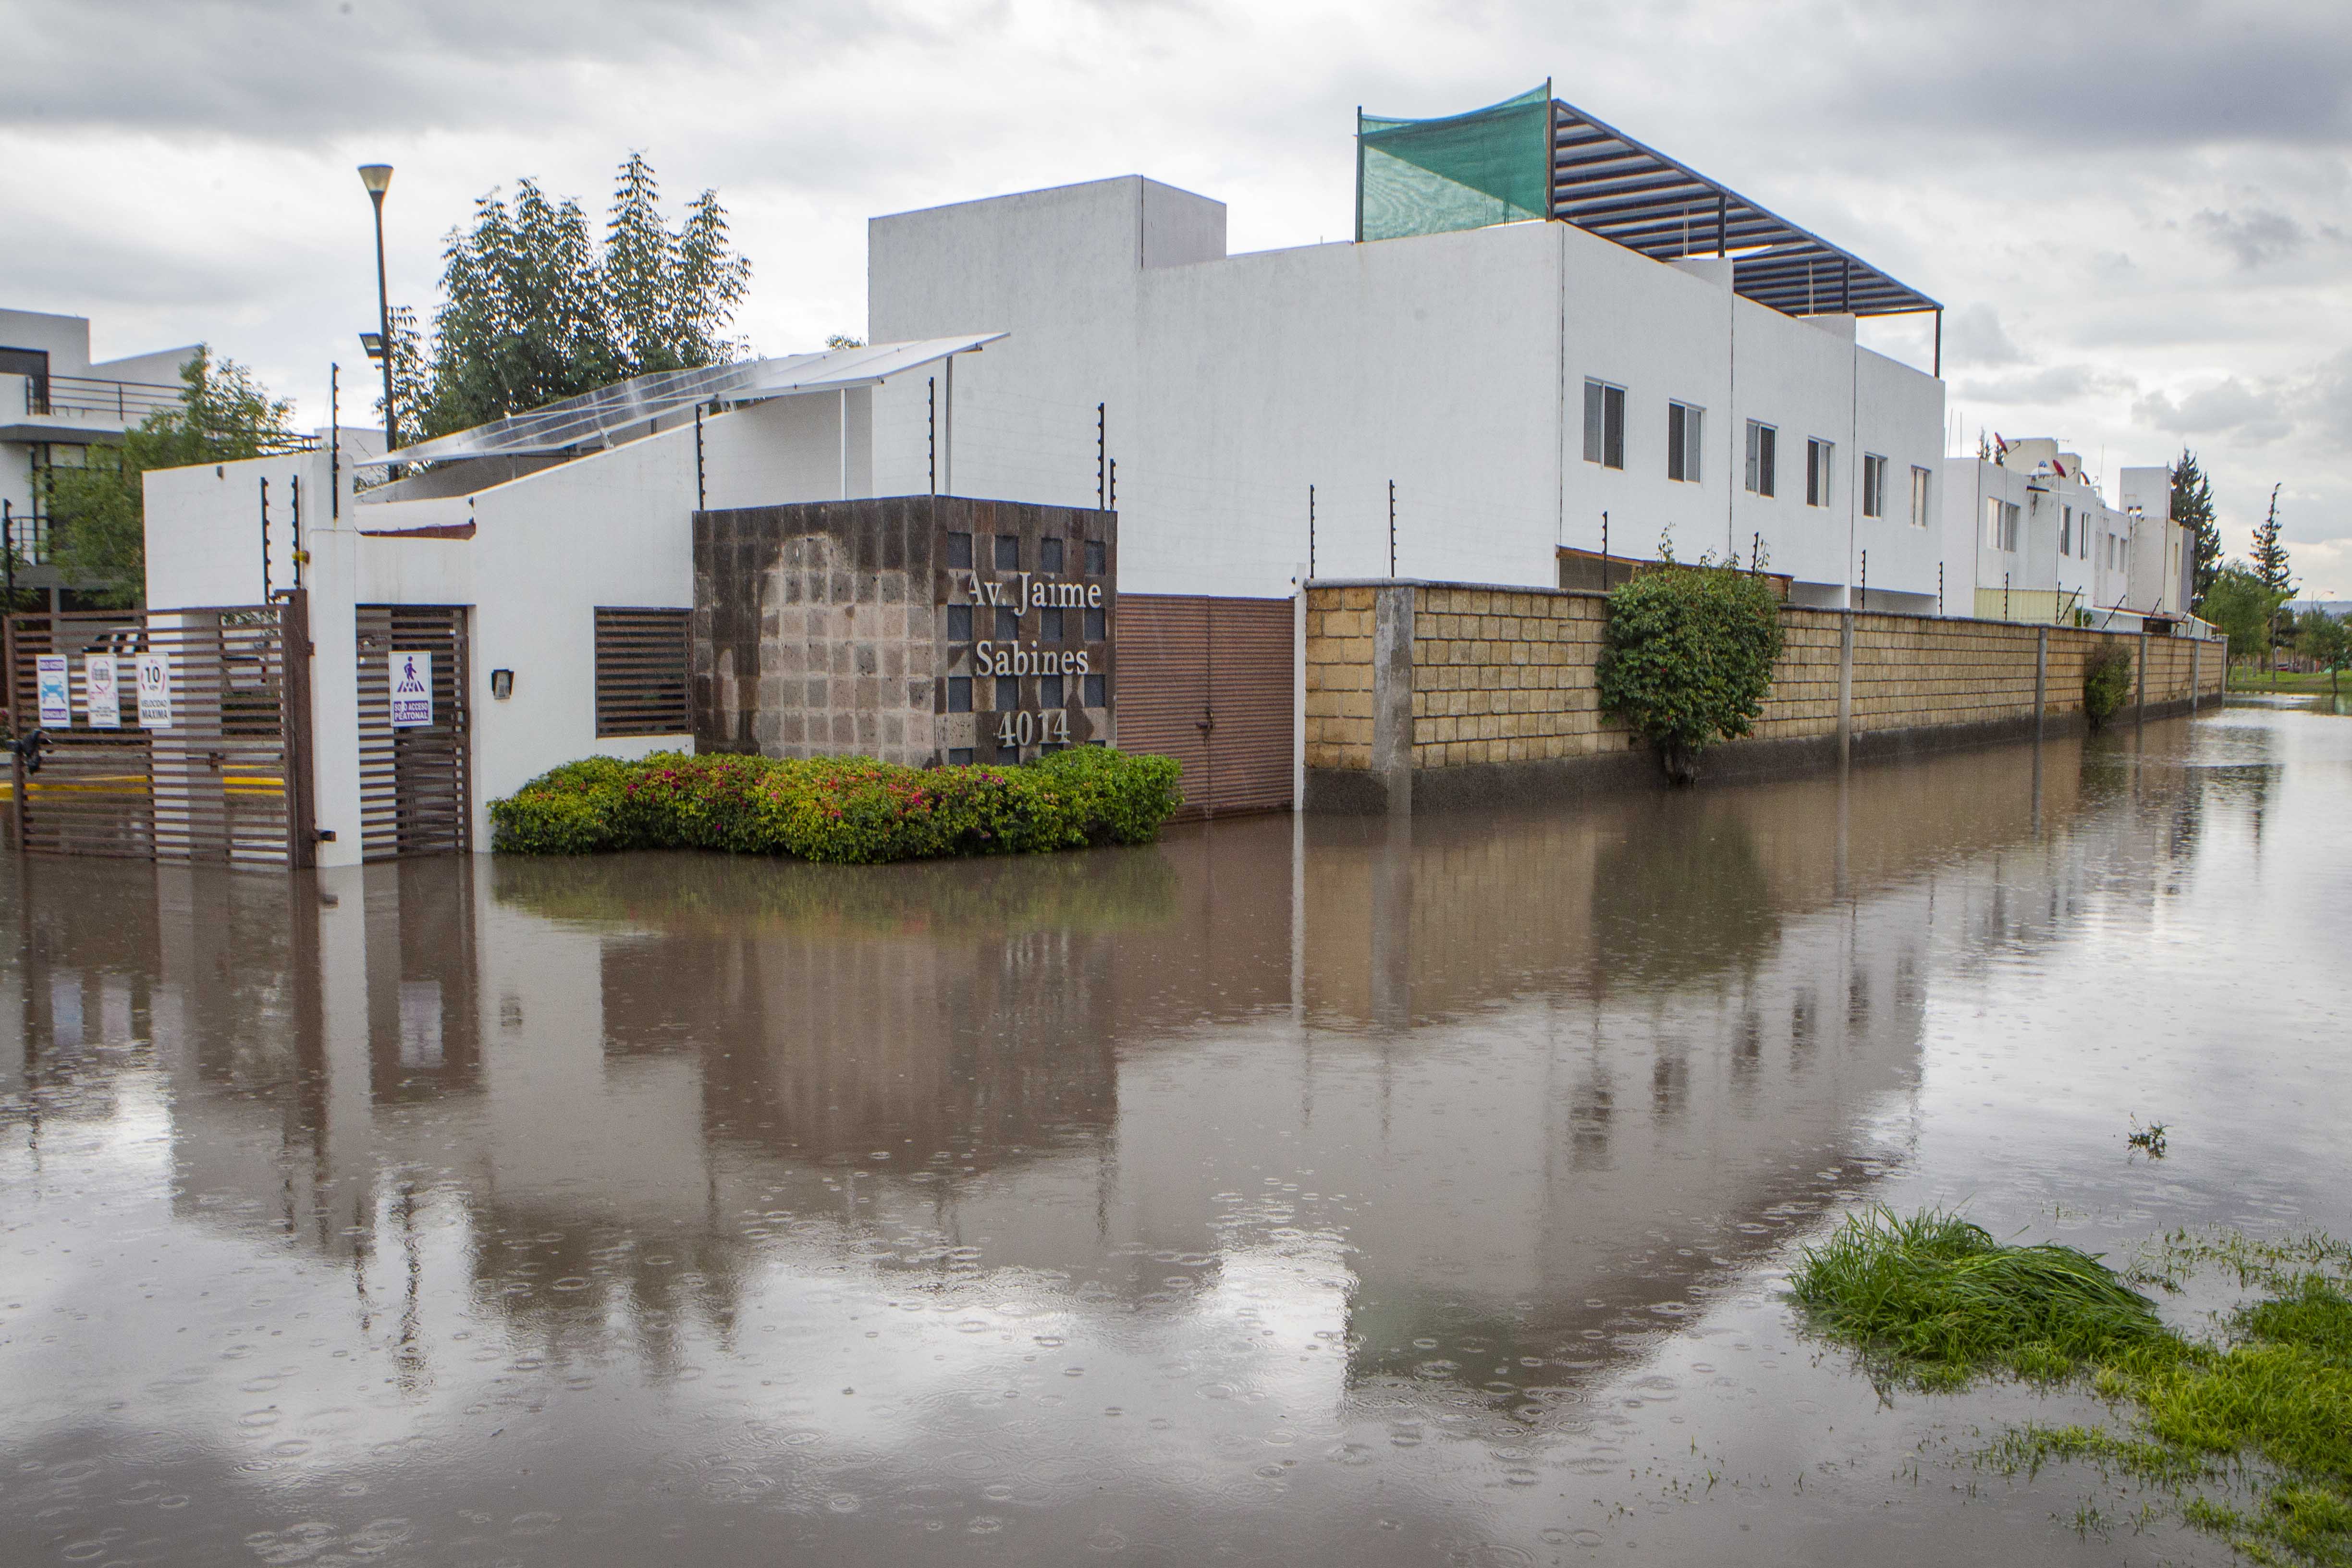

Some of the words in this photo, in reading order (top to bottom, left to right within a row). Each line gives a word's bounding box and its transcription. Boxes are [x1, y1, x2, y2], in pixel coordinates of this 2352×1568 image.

[968, 570, 1006, 607] Av.
[1014, 571, 1102, 616] Jaime
[976, 640, 1090, 677] Sabines
[145, 666, 160, 683] 10
[394, 711, 428, 721] PEATONAL
[408, 702, 428, 711] ACCESO
[997, 710, 1071, 747] 4014
